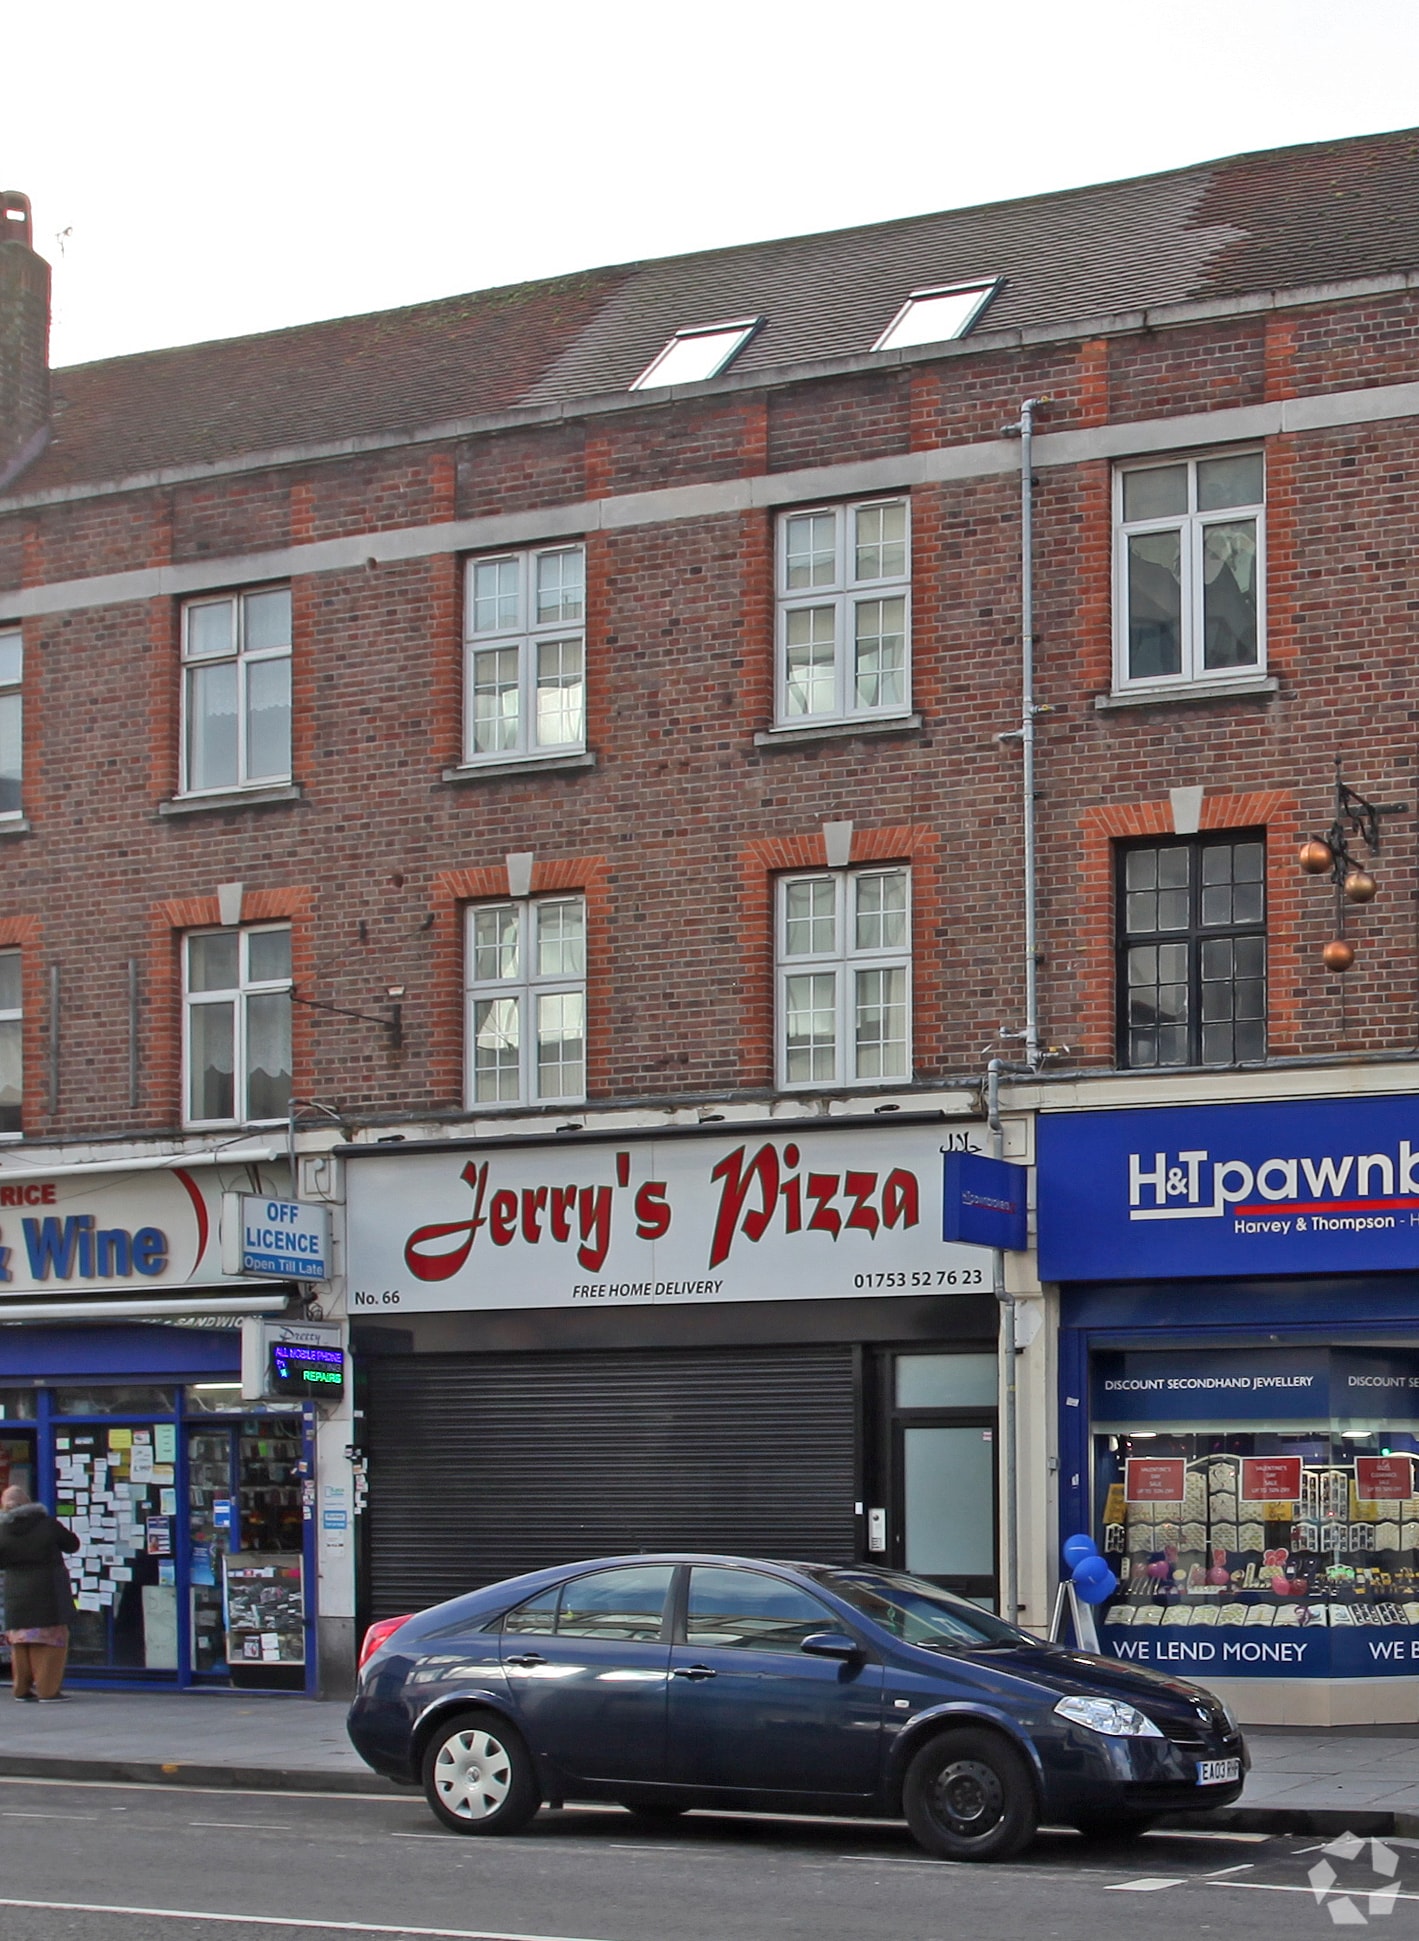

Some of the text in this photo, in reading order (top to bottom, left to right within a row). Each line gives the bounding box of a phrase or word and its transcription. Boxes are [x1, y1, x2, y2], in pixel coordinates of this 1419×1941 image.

[266, 1202, 299, 1224] OFF
[404, 1142, 920, 1282] Jerry's Pizza
[1234, 1216, 1291, 1235] Harvey
[1295, 1216, 1307, 1231] &
[1312, 1215, 1395, 1232] Thompson
[21, 1214, 169, 1281] Wine
[246, 1227, 320, 1254] LICENCE
[244, 1255, 323, 1276] Open Till Late
[853, 1268, 983, 1289] 01753 52 76 23
[355, 1290, 400, 1305] No. 66
[572, 1280, 724, 1299] FREE HOME DELIVERY
[303, 1370, 342, 1384] REPAIRS
[1104, 1375, 1314, 1391] DISCOUNT SECONDHAND JEWELLERY
[1347, 1376, 1405, 1388] DISCOUNT
[1112, 1640, 1308, 1662] WE LEND MONEY
[1368, 1641, 1405, 1660] WE
[1202, 1762, 1226, 1781] EA03
